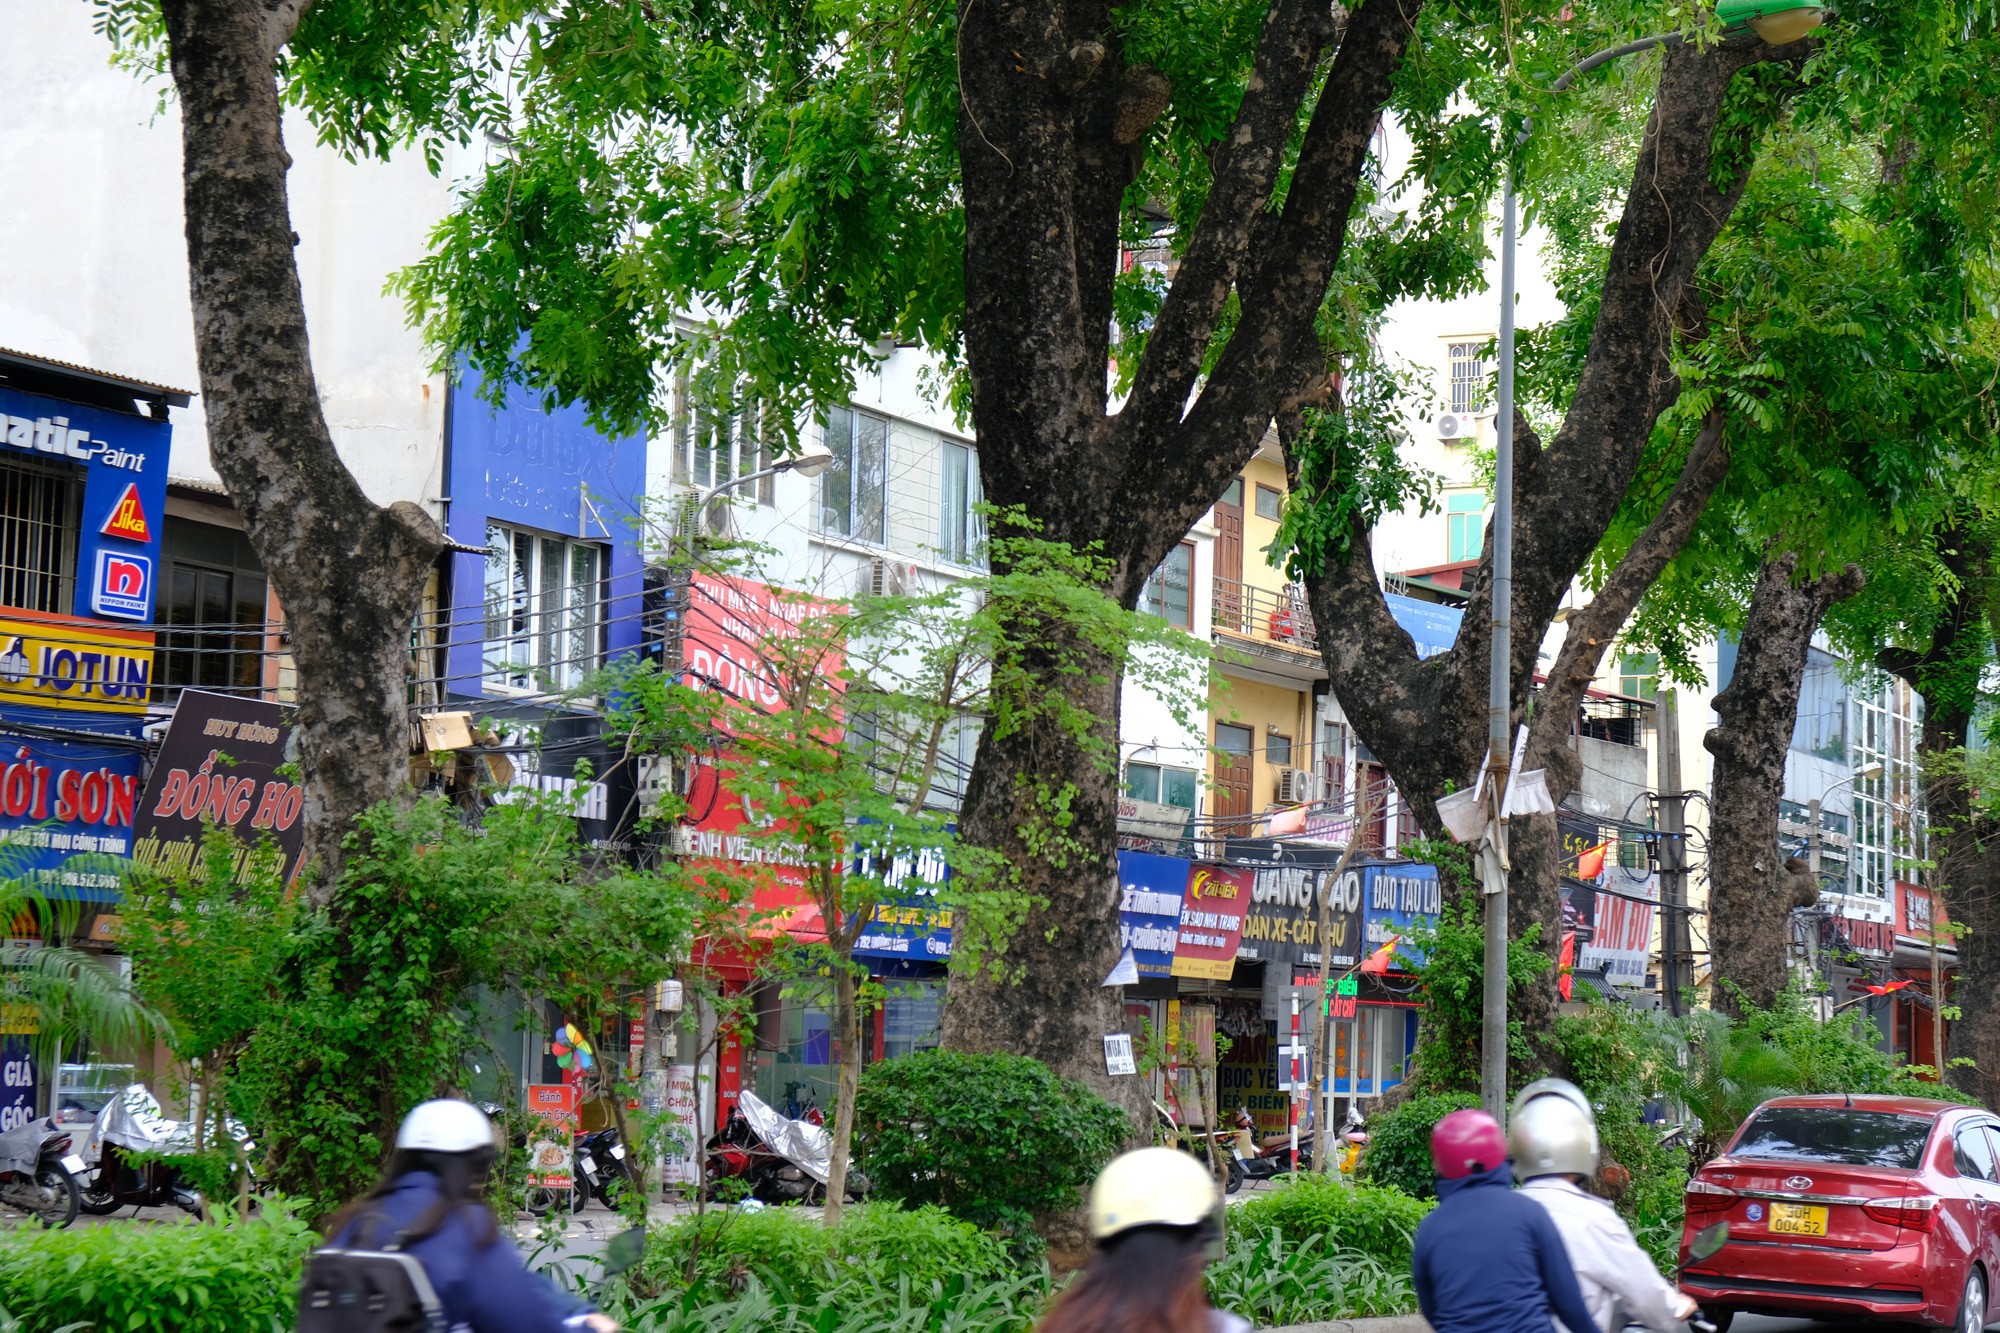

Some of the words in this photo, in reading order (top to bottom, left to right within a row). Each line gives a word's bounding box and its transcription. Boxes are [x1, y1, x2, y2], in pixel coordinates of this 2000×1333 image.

[86, 439, 147, 473] Paint
[112, 499, 146, 534] Sika
[99, 596, 124, 608] NIPPON
[125, 601, 146, 611] PAINT
[33, 645, 149, 700] JOTUN
[203, 718, 239, 738] HUY
[54, 767, 138, 827] SƠN
[51, 833, 71, 854] MỌI
[72, 832, 98, 852] CÔNG
[99, 834, 127, 854] TRÌNH
[4, 1053, 33, 1087] GIÁ
[1, 1095, 34, 1132] GỐC
[1775, 1219, 1821, 1235] 004.52
[1786, 1205, 1811, 1219] 30H
